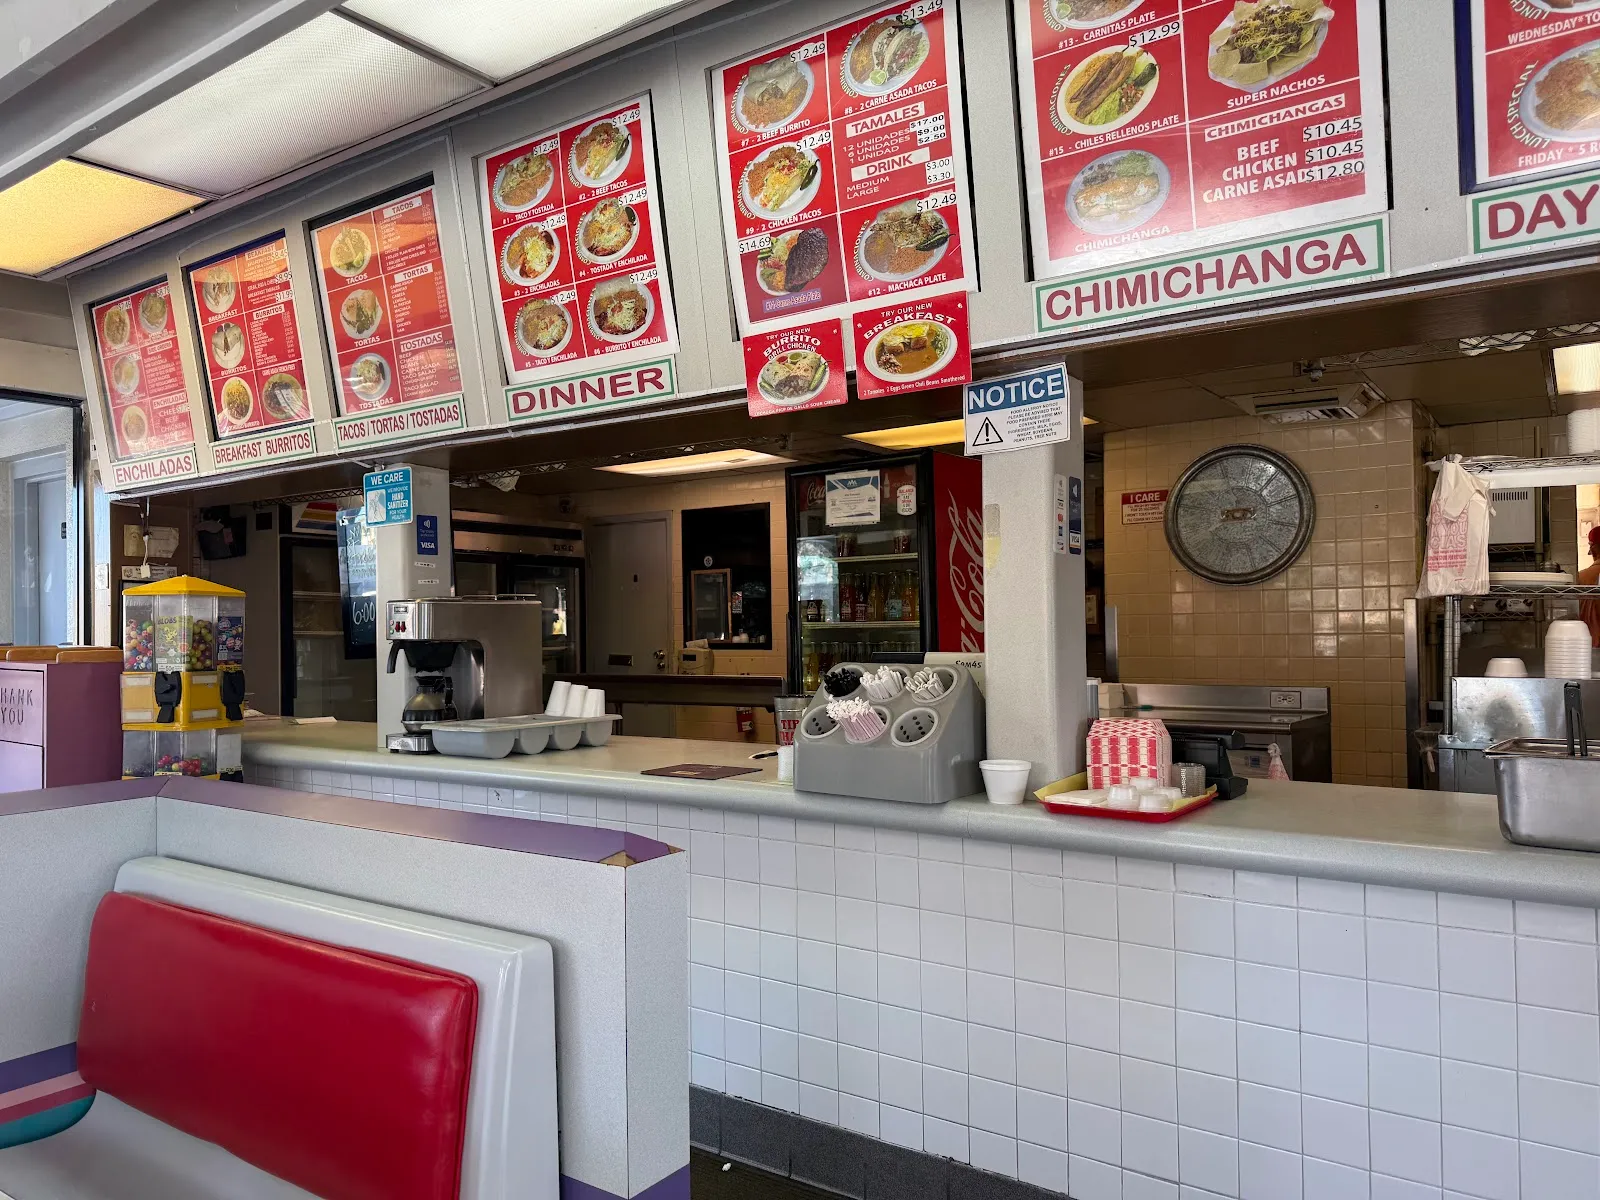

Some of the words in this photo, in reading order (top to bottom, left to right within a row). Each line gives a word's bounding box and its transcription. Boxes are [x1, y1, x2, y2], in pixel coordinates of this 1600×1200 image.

[902, 0, 942, 20] $13.49
[1058, 38, 1073, 49] #13
[1083, 20, 1126, 40] CARNITAS
[1128, 11, 1155, 27] PLATE
[1130, 22, 1180, 48] $12.99
[790, 43, 825, 63] $12.49
[865, 95, 888, 108] CARNE
[889, 87, 913, 101] ASADA
[914, 79, 937, 93] TACOS
[1050, 64, 1072, 136] COMBINACIONES
[1227, 92, 1267, 109] SUPER
[1270, 75, 1325, 97] NACHOS
[1507, 60, 1538, 123] SPECIAL
[612, 110, 640, 127] $12.49
[852, 105, 920, 133] TAMALES
[1207, 97, 1343, 139] CHIMICHANGAS
[762, 129, 779, 140] BEEF
[780, 119, 810, 135] BURRITO
[856, 128, 910, 148] UNIDADES
[910, 115, 944, 128] $17.00
[856, 135, 910, 155] UNIDADES
[917, 124, 945, 136] $9.00
[1049, 146, 1064, 156] #15
[1075, 132, 1104, 150] CHILES
[1106, 122, 1150, 142] RELLENOS
[1151, 115, 1179, 130] PLATE
[1237, 139, 1280, 161] BEEF
[1303, 117, 1362, 141] $10.45
[1510, 118, 1551, 149] LUNCH
[533, 139, 558, 156] $12.49
[796, 132, 831, 150] $12.49
[858, 146, 899, 162] UNIDAD
[918, 132, 946, 144] $2.50
[866, 154, 913, 176] DRINK
[1222, 152, 1297, 182] CHICKEN
[1305, 140, 1363, 163] $10.45
[1518, 148, 1563, 167] FRIDAY
[846, 176, 890, 192] MEDIUM
[926, 159, 950, 171] $3.00
[1203, 179, 1259, 203] CARNE
[1306, 161, 1364, 182] $12.80
[596, 186, 610, 195] BEEF
[610, 180, 628, 191] TACOS
[847, 186, 879, 200] LARGE
[928, 172, 950, 183] $3.30
[392, 201, 413, 214] TACOS
[618, 189, 647, 206] $12.49
[917, 194, 956, 211] $12.49
[515, 211, 528, 222] TACO
[532, 203, 554, 215] TOSTADA
[768, 215, 798, 229] CHICKEN
[799, 209, 822, 221] TACOS
[1488, 184, 1600, 240] DAY
[540, 215, 566, 230] $12.49
[740, 237, 771, 253] $14.69
[1075, 226, 1170, 253] CHIMICHANGA
[854, 220, 874, 282] COMBINACIONES
[403, 266, 428, 279] TORTAS
[590, 263, 612, 274] TOSTADA
[618, 254, 647, 267] ENCHILADA
[346, 273, 367, 284] TACOS
[530, 280, 560, 293] ENCHILADAS
[630, 269, 657, 284] $12.49
[868, 288, 880, 296] #12
[888, 278, 923, 292] MACHACA
[924, 273, 946, 284] PLATE
[1046, 233, 1366, 320] CHIMICHANGA
[550, 291, 576, 304] $12.49
[208, 309, 238, 322] BREAKFAST
[256, 306, 283, 318] BURRITOS
[881, 310, 894, 318] TRY
[916, 302, 932, 310] NEW
[796, 327, 810, 335] NEW
[864, 312, 956, 339] BREAKFAST
[354, 336, 380, 348] TORTAS
[401, 333, 442, 351] TOSTADAS
[605, 343, 627, 353] BURRITO
[632, 336, 662, 347] ENCHILADA
[763, 335, 821, 357] BURRITO
[768, 345, 786, 360] GRILL
[788, 342, 816, 352] CHICKEN
[536, 357, 547, 365] TACO
[551, 351, 577, 363] ENCHILADA
[221, 365, 246, 376] BURRITOS
[153, 393, 185, 407] ENCHILADAS
[512, 367, 665, 414] DINNER
[969, 374, 1063, 410] NOTICE
[359, 397, 394, 410] TOSTADAS
[337, 423, 365, 440] TACOS
[371, 414, 404, 435] TORTAS
[410, 404, 459, 428] TOSTADAS
[215, 442, 261, 463] BREAKFAST
[266, 433, 310, 455] BURRITOS
[116, 455, 192, 483] ENCHILADAS
[371, 475, 382, 485] WE
[384, 472, 403, 483] CARE
[388, 500, 408, 509] SANITIZER
[392, 492, 404, 500] HAND
[1130, 494, 1133, 503] I
[1136, 492, 1160, 502] CARE
[0, 688, 33, 706] HANK
[0, 707, 24, 725] YOU
